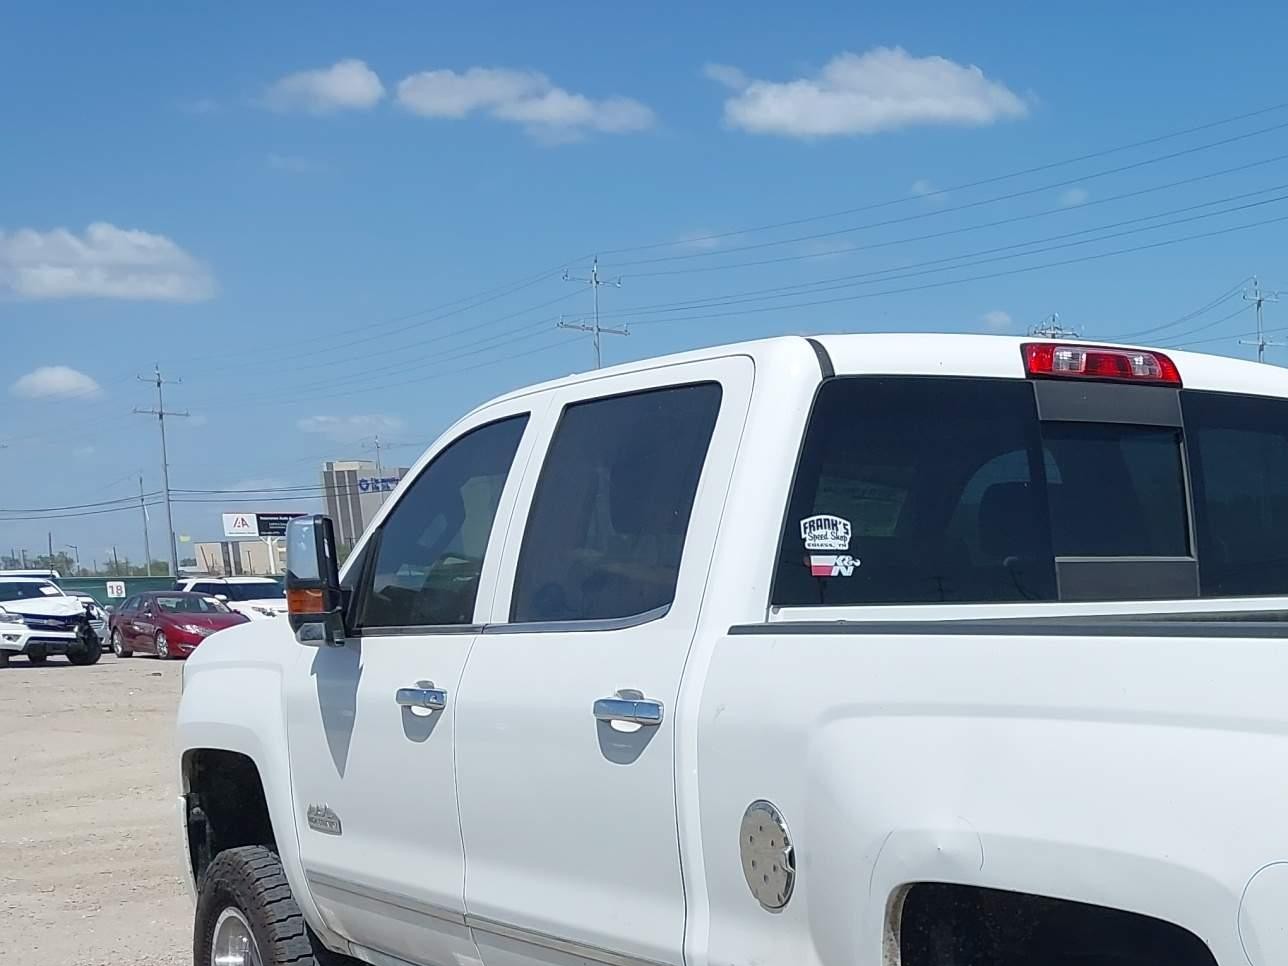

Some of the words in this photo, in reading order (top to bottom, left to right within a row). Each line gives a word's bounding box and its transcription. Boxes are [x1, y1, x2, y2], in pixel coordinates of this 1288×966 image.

[803, 518, 848, 535] FRANK'S
[808, 531, 828, 542] Speed
[831, 531, 847, 543] Shop
[109, 585, 124, 595] 18
